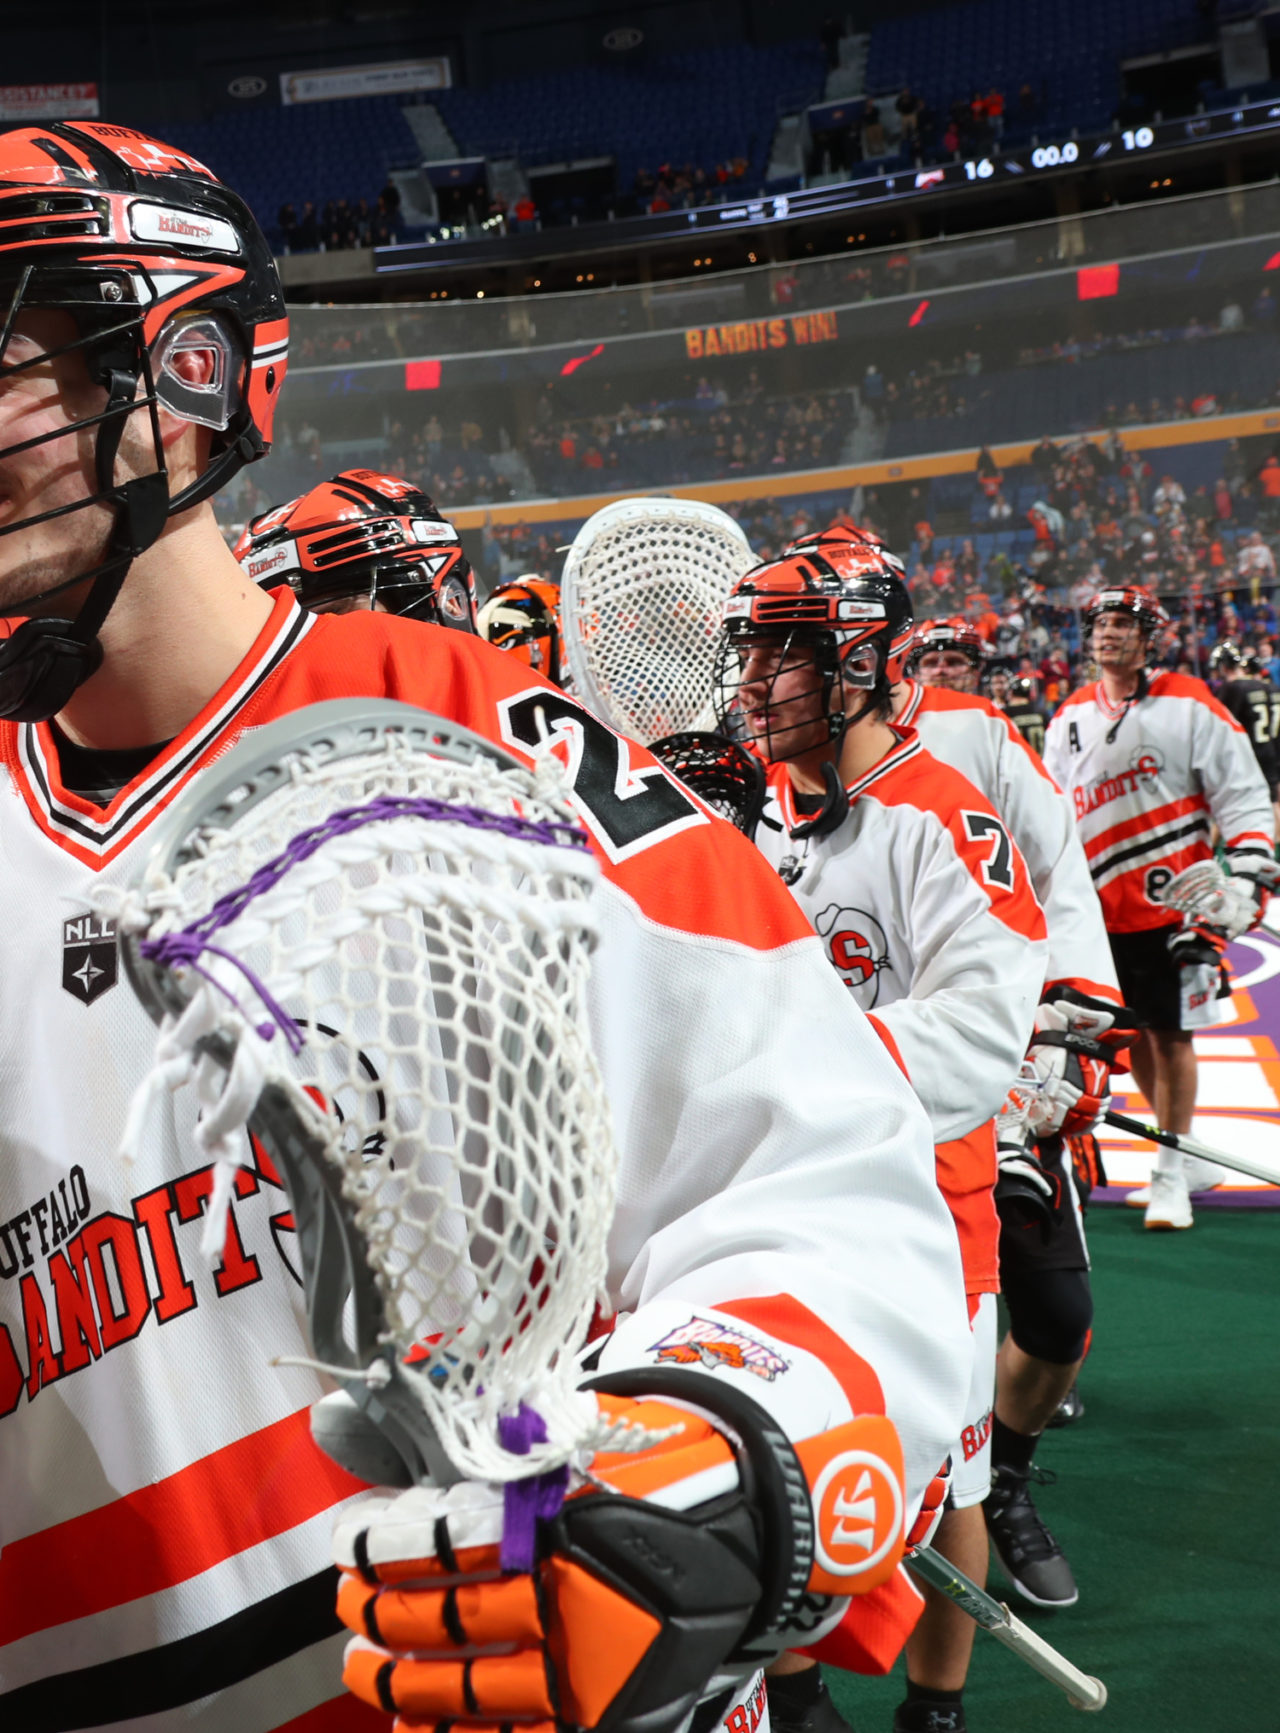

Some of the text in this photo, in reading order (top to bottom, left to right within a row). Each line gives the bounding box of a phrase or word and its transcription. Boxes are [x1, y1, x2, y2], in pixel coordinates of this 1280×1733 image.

[964, 158, 994, 180] 16
[1032, 142, 1079, 168] 00.0
[1121, 127, 1154, 151] 10
[686, 310, 838, 359] BANDITS WIN!
[1069, 722, 1082, 754] A
[496, 686, 711, 865] 2
[1073, 756, 1158, 822] BANDITS
[960, 809, 1014, 893] 7
[66, 918, 115, 941] NLL
